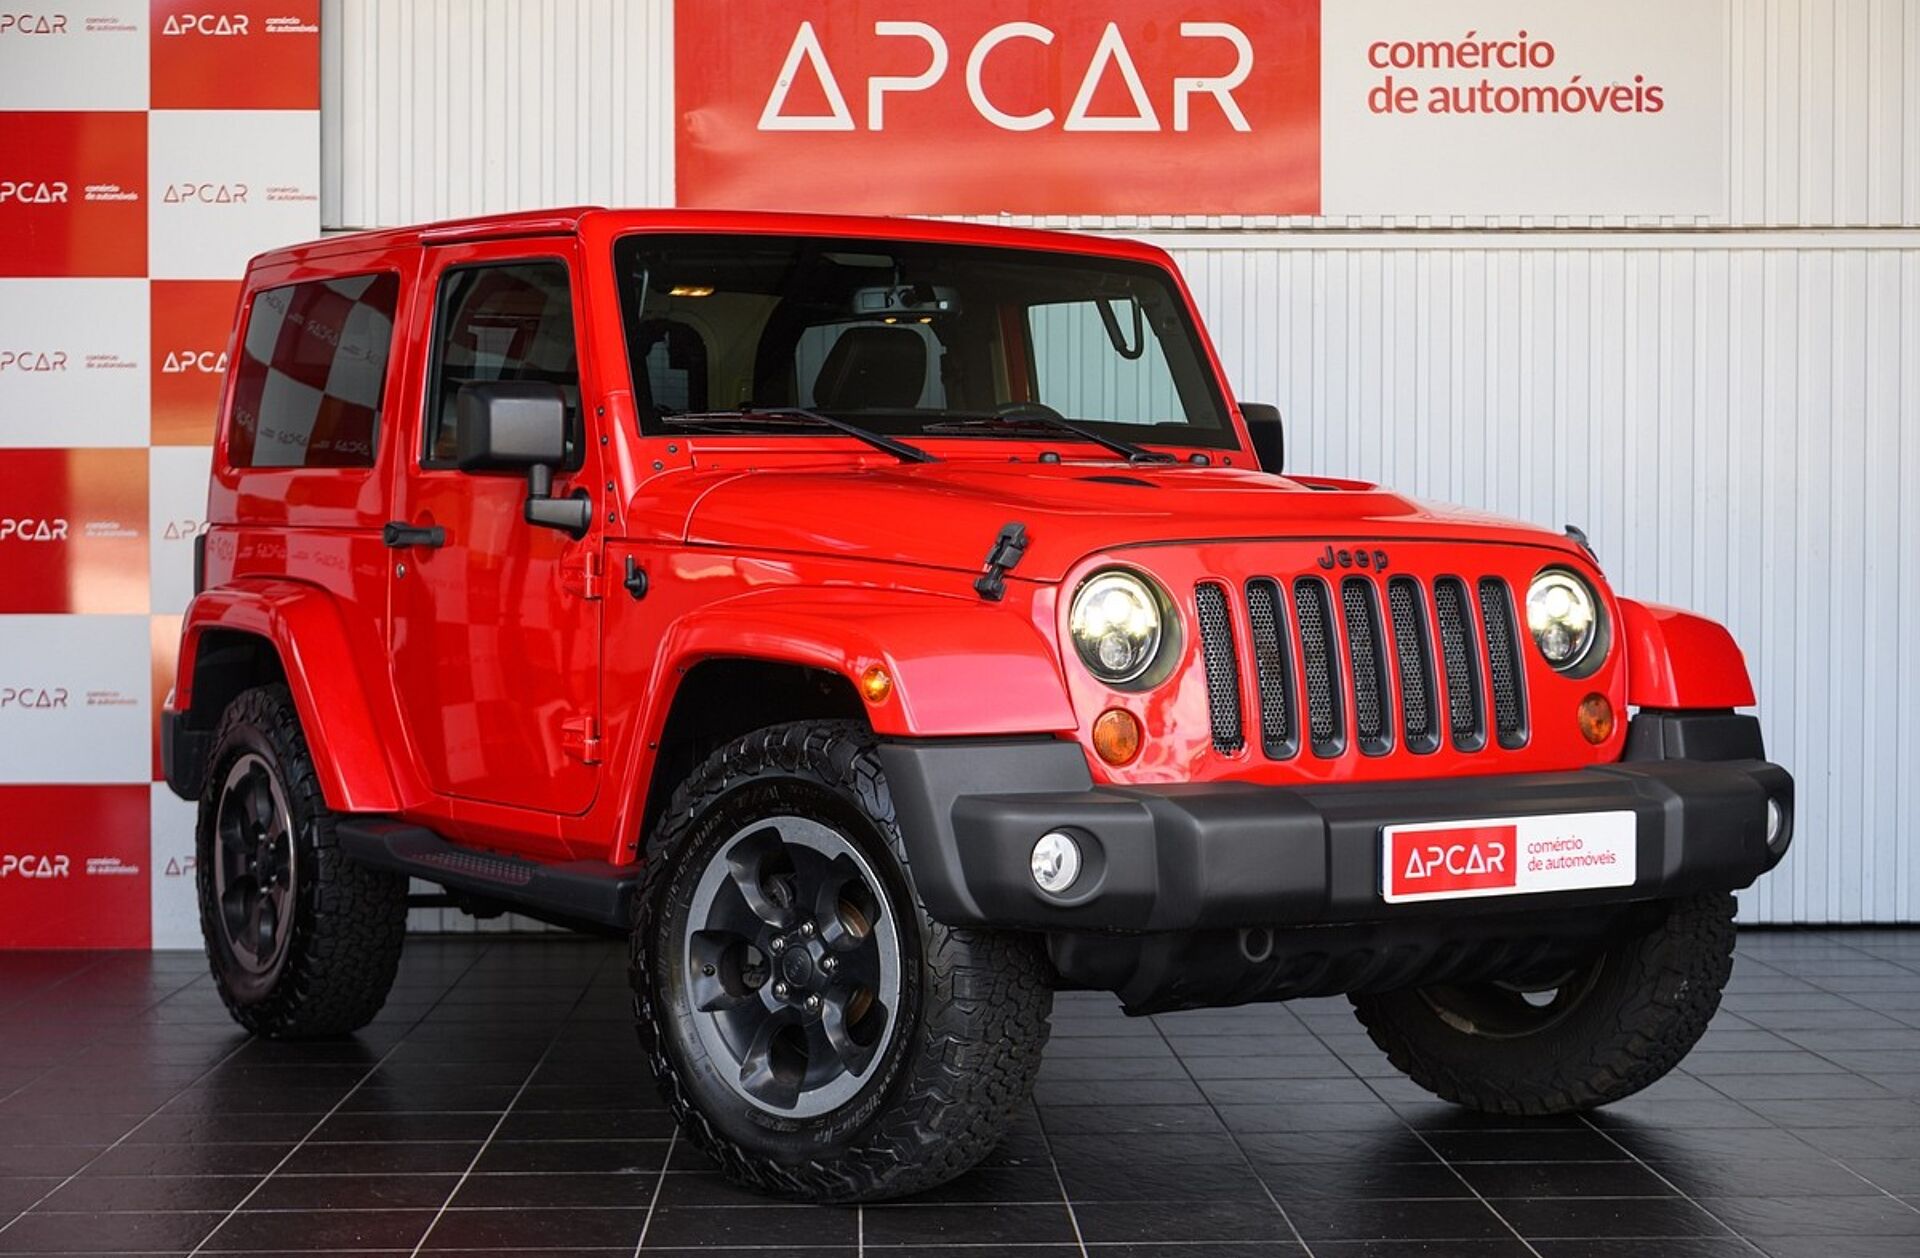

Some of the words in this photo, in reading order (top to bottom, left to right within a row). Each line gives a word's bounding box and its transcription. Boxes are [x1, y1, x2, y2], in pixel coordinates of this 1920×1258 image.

[0, 14, 67, 34] PCAR
[162, 14, 249, 36] APCAR
[1368, 30, 1554, 69] comércio
[757, 20, 1254, 133] APCAR
[1368, 74, 1420, 114] de
[1428, 74, 1664, 114] automóveis
[0, 182, 68, 203] PCAR
[163, 184, 248, 203] APCAR
[0, 351, 67, 371] PCAR
[0, 518, 68, 541] PCAR
[1317, 545, 1389, 574] Jeep
[1, 688, 68, 707] PCAR
[1527, 835, 1583, 854] comércio
[0, 855, 70, 878] PCAR
[1404, 842, 1505, 879] APCAR
[1527, 858, 1543, 872] de
[1545, 850, 1616, 871] automóveis
